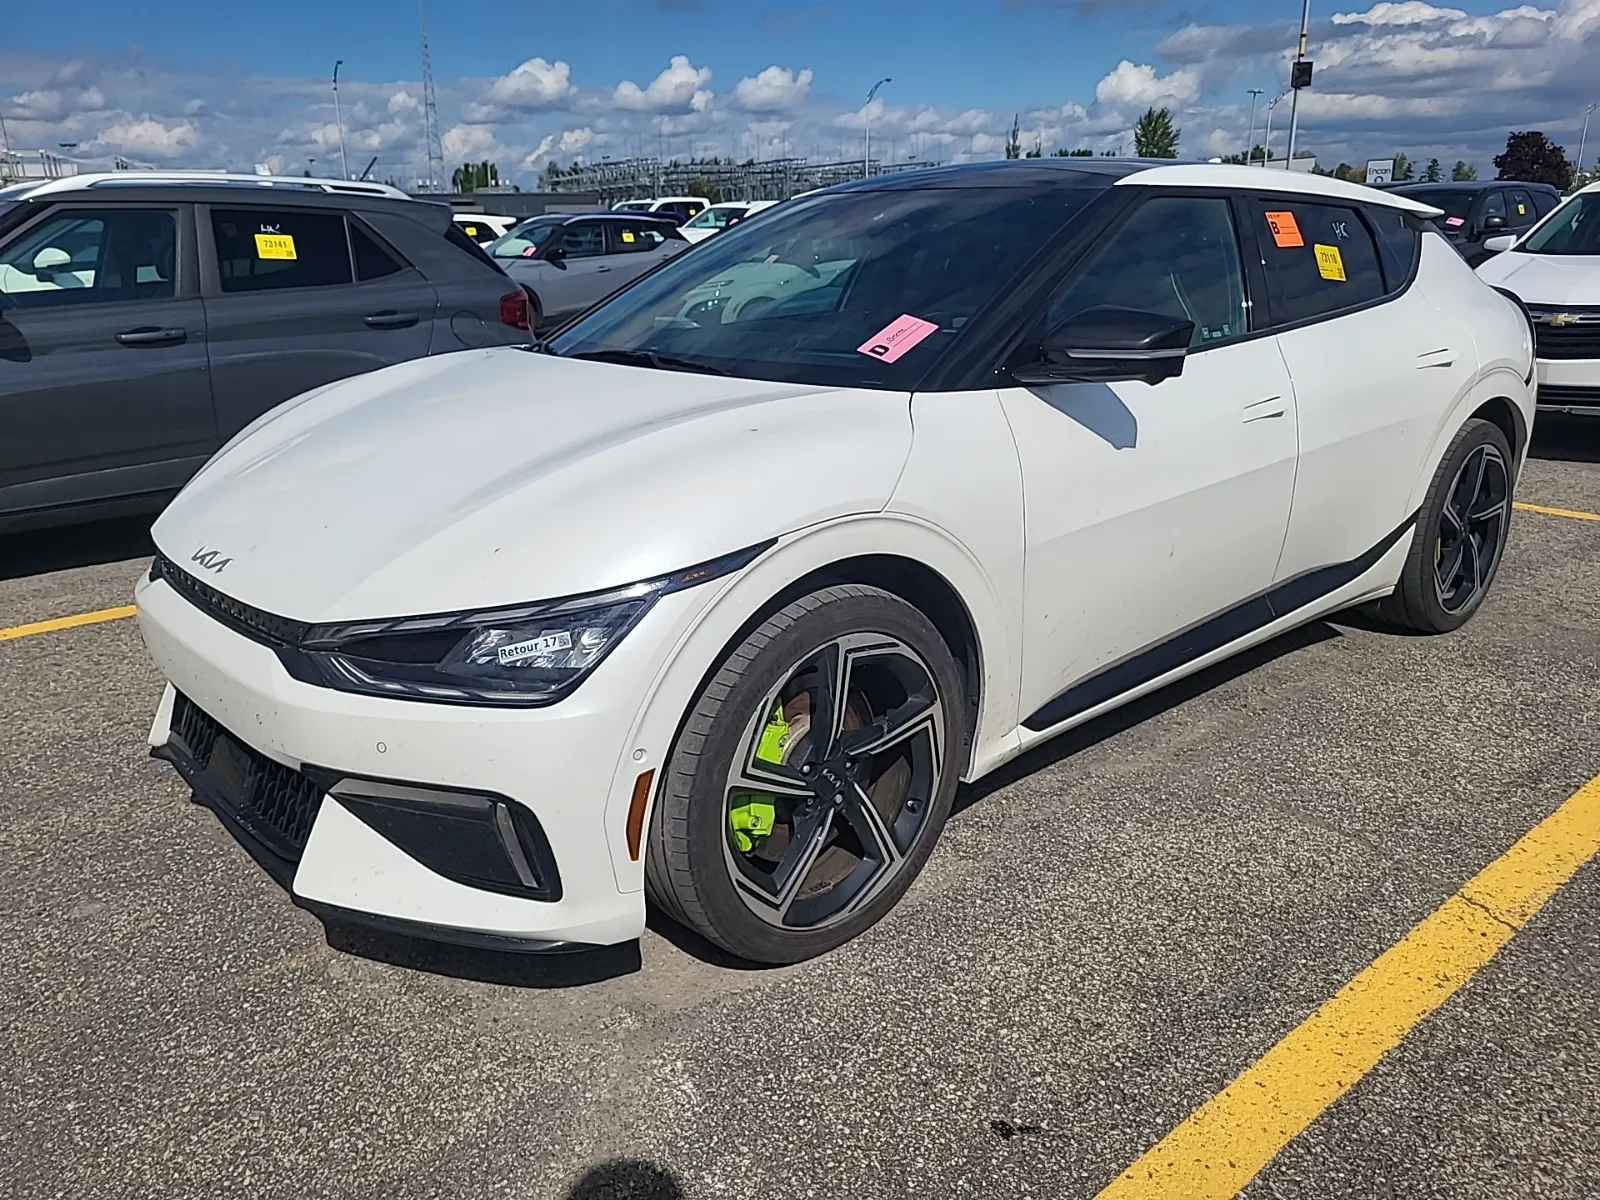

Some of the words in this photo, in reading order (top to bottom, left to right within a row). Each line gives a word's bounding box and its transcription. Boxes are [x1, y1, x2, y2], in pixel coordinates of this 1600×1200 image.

[1270, 221, 1280, 234] B
[868, 344, 889, 356] D
[191, 545, 233, 574] KIA
[500, 642, 539, 659] Retour
[543, 636, 557, 648] 17
